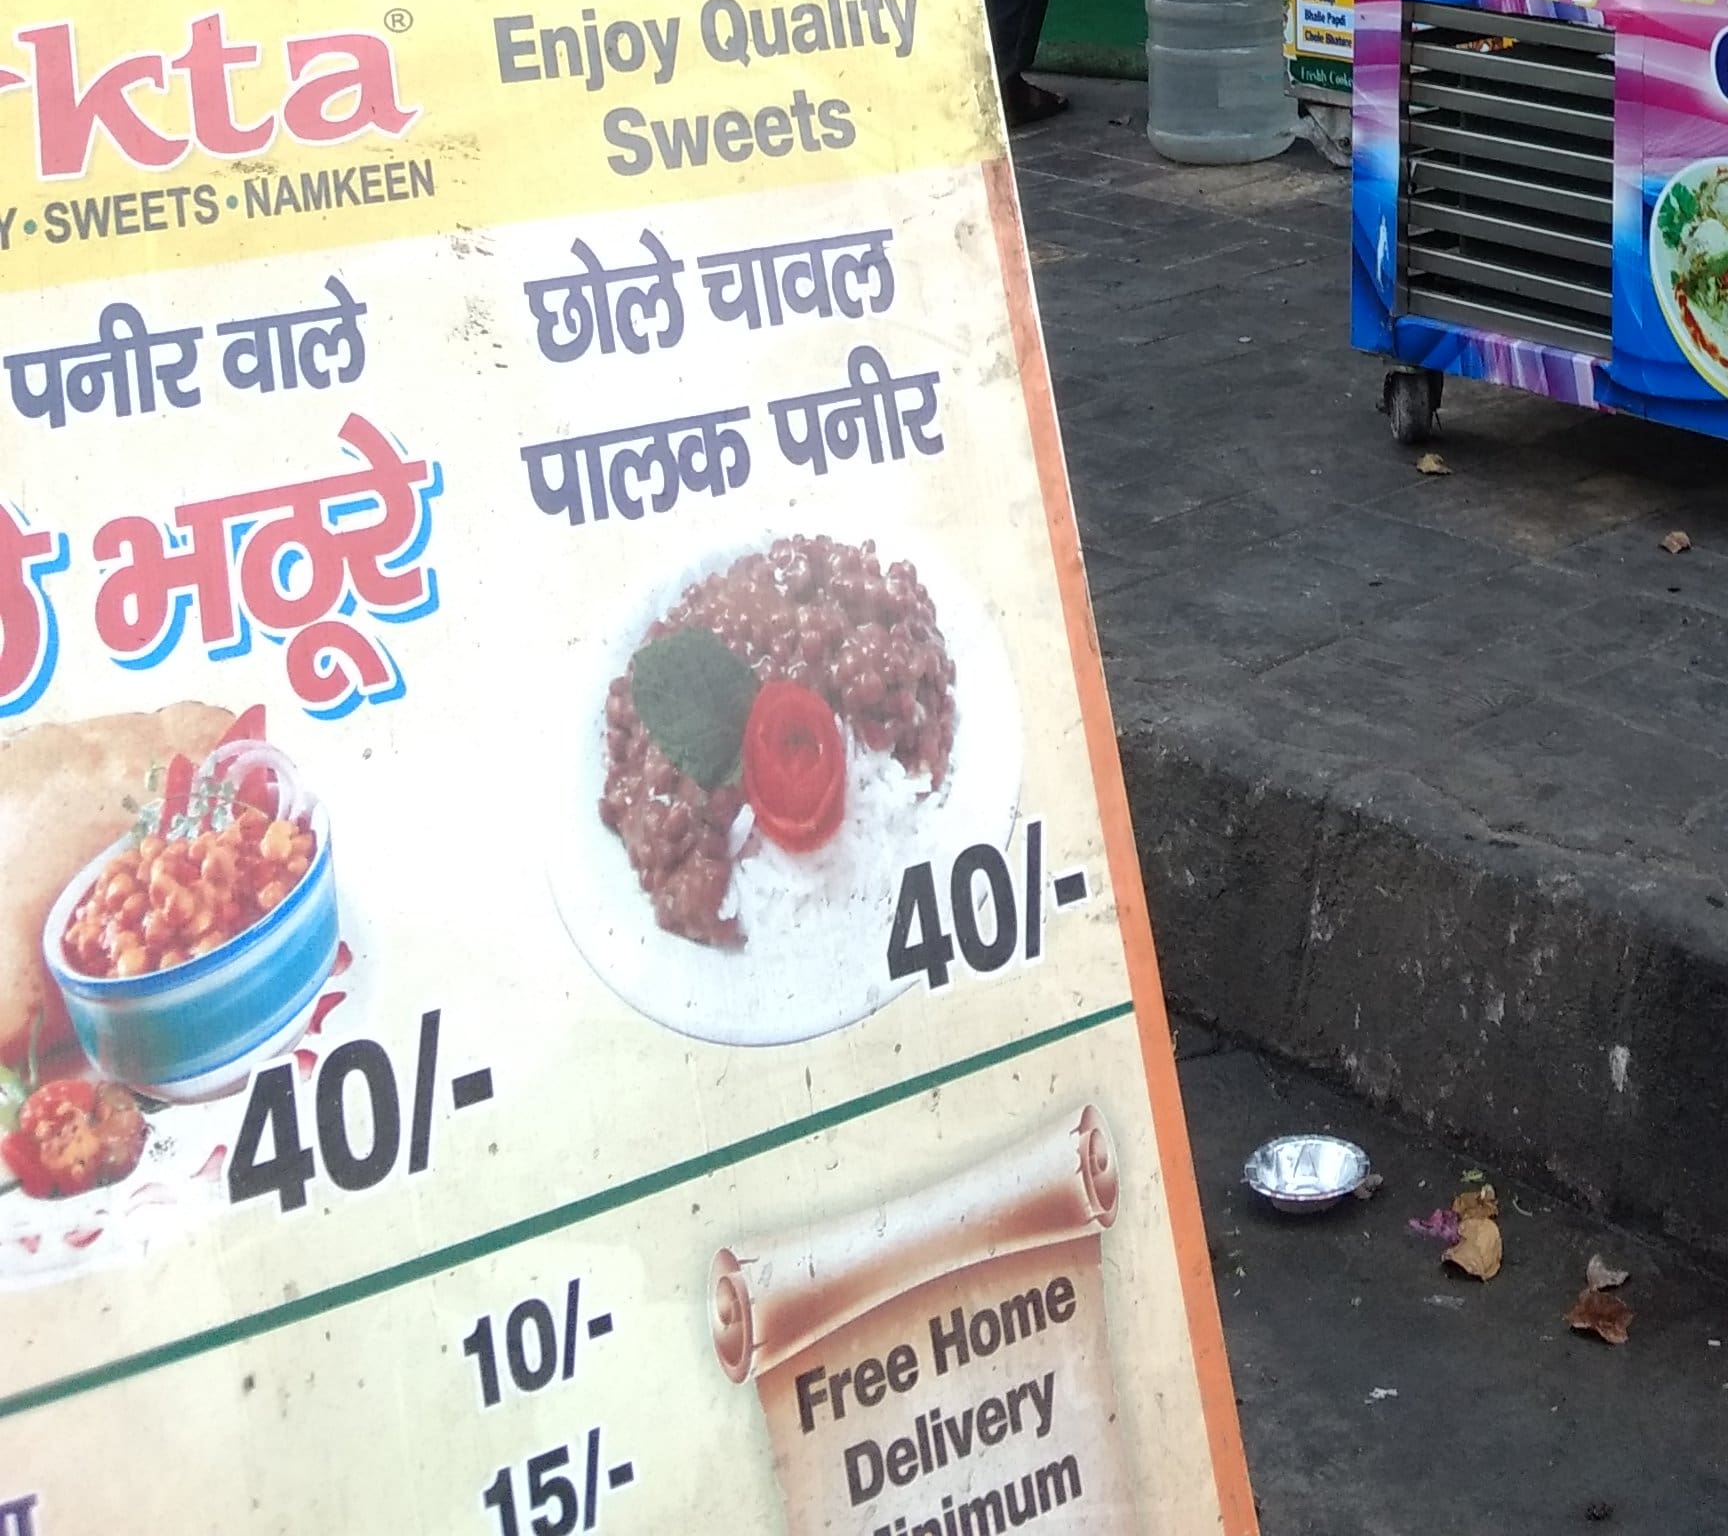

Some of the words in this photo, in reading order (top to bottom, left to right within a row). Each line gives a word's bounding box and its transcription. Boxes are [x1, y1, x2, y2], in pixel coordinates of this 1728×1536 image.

[0, 12, 421, 177] kta
[492, 10, 680, 92] Enjoy
[43, 183, 221, 244] SWEETS
[243, 159, 436, 221] NAMKEEN
[600, 90, 857, 178] Sweets
[4, 301, 203, 429] पनीर
[217, 275, 367, 393] वाले
[523, 226, 684, 366] छोले
[700, 228, 896, 335] चावल
[520, 405, 751, 527] पालक
[768, 343, 946, 480] पनीर
[93, 412, 438, 712] भठूरे
[885, 820, 1090, 992] 40/-
[225, 1008, 496, 1215] 40/-
[461, 1277, 616, 1411] 10/-
[795, 1342, 919, 1436] Free
[928, 1275, 1077, 1375] Home
[482, 1427, 637, 1536] 15/-
[844, 1370, 1056, 1507] Delivery
